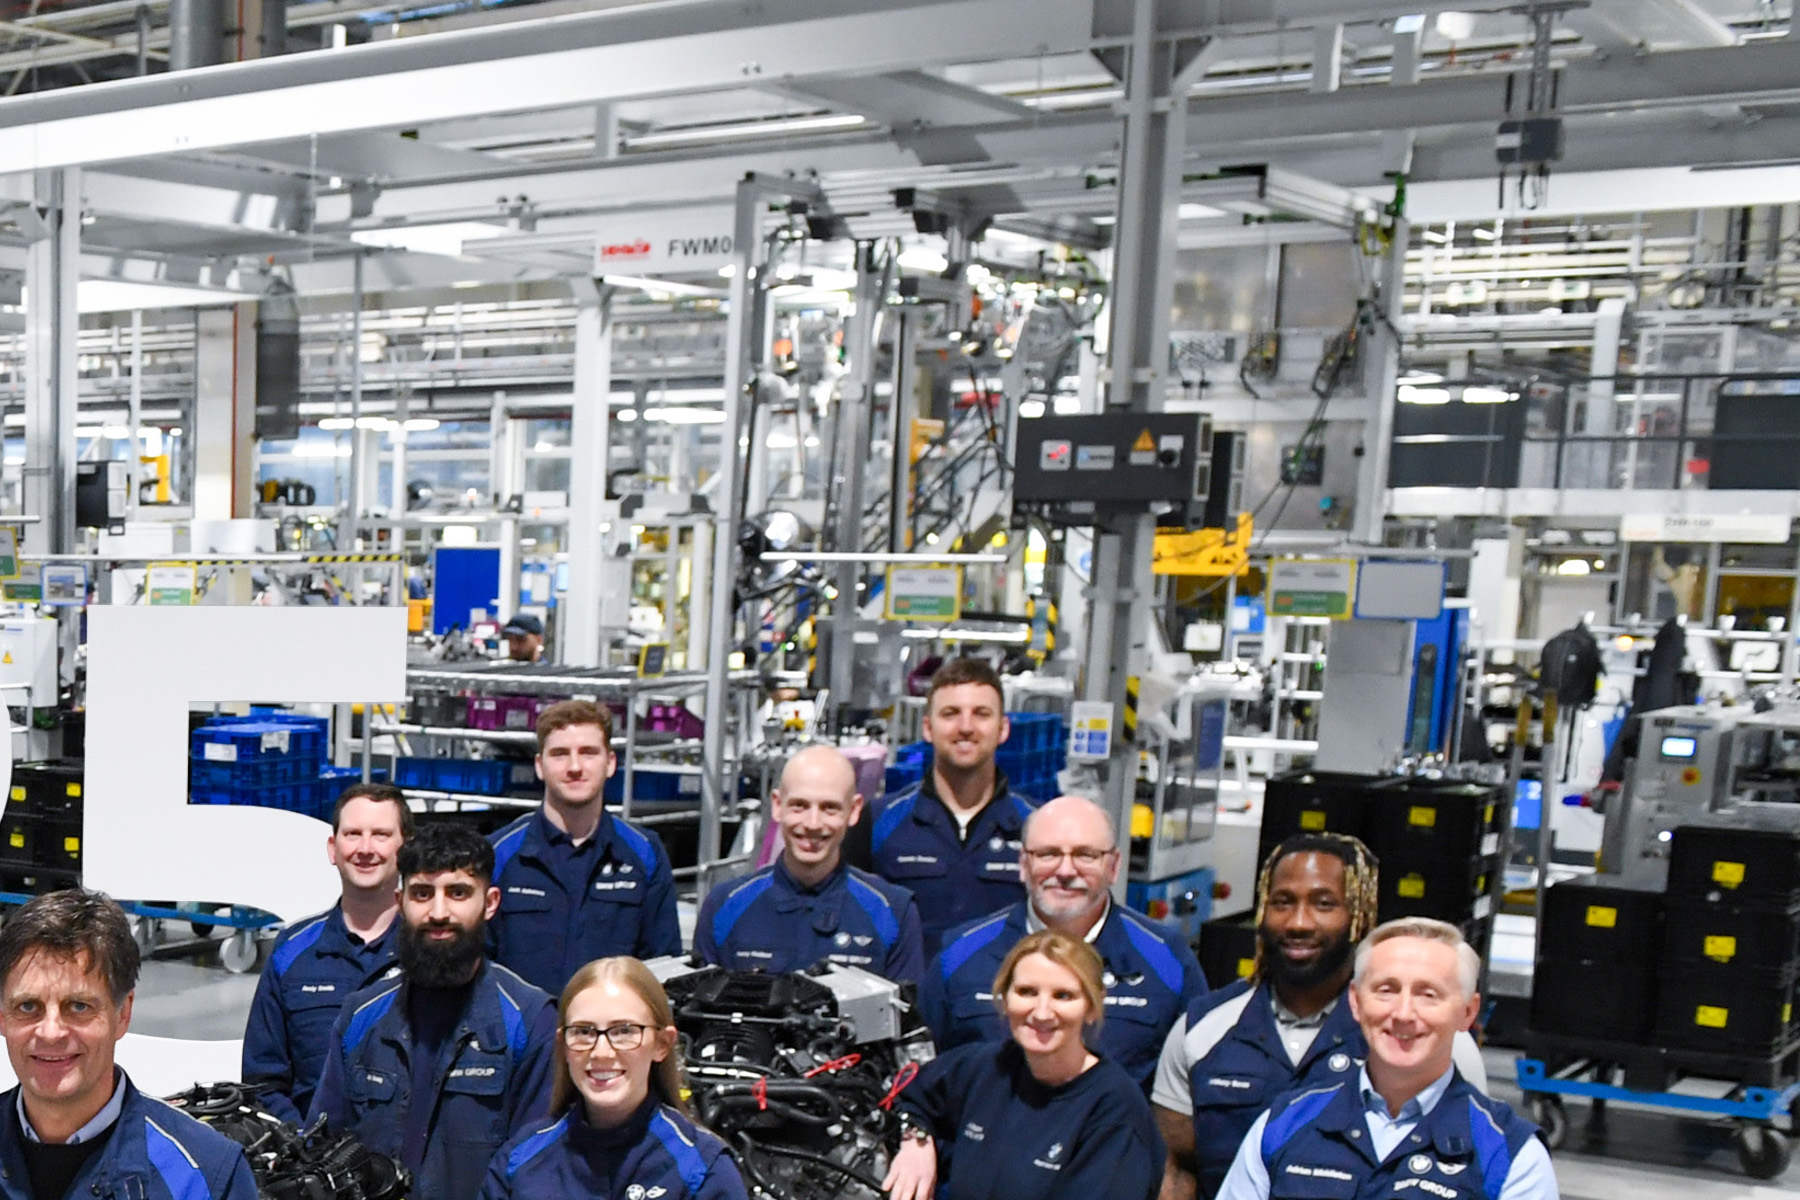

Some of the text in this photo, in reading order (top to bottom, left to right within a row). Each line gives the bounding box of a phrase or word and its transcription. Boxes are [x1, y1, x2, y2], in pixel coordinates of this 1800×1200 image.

[668, 237, 732, 256] FWM0
[465, 1068, 495, 1076] GROUP
[1419, 1180, 1457, 1198] GROUP
